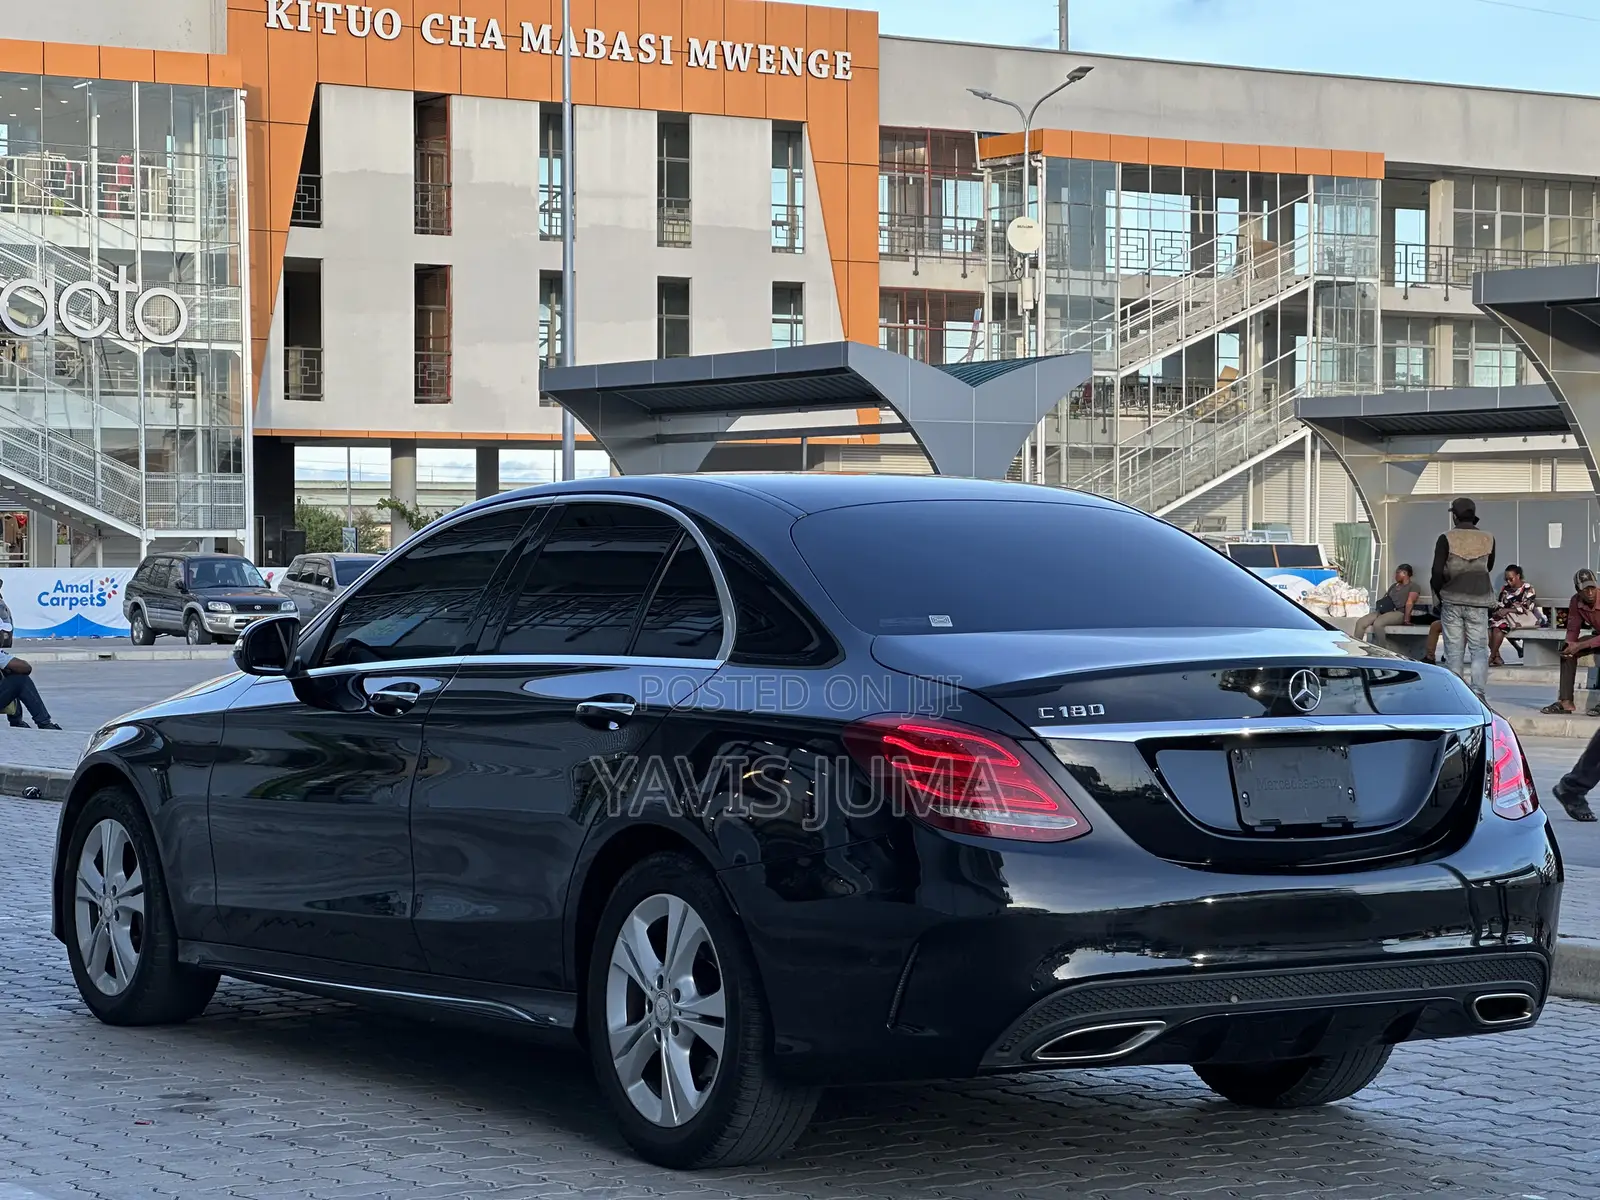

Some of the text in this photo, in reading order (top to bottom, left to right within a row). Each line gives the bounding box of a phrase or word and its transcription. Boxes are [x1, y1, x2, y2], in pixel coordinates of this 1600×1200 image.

[265, 0, 852, 81] KITUO CHA MABASI MWENGE
[53, 579, 93, 593] Amal
[1038, 703, 1105, 719] C 180
